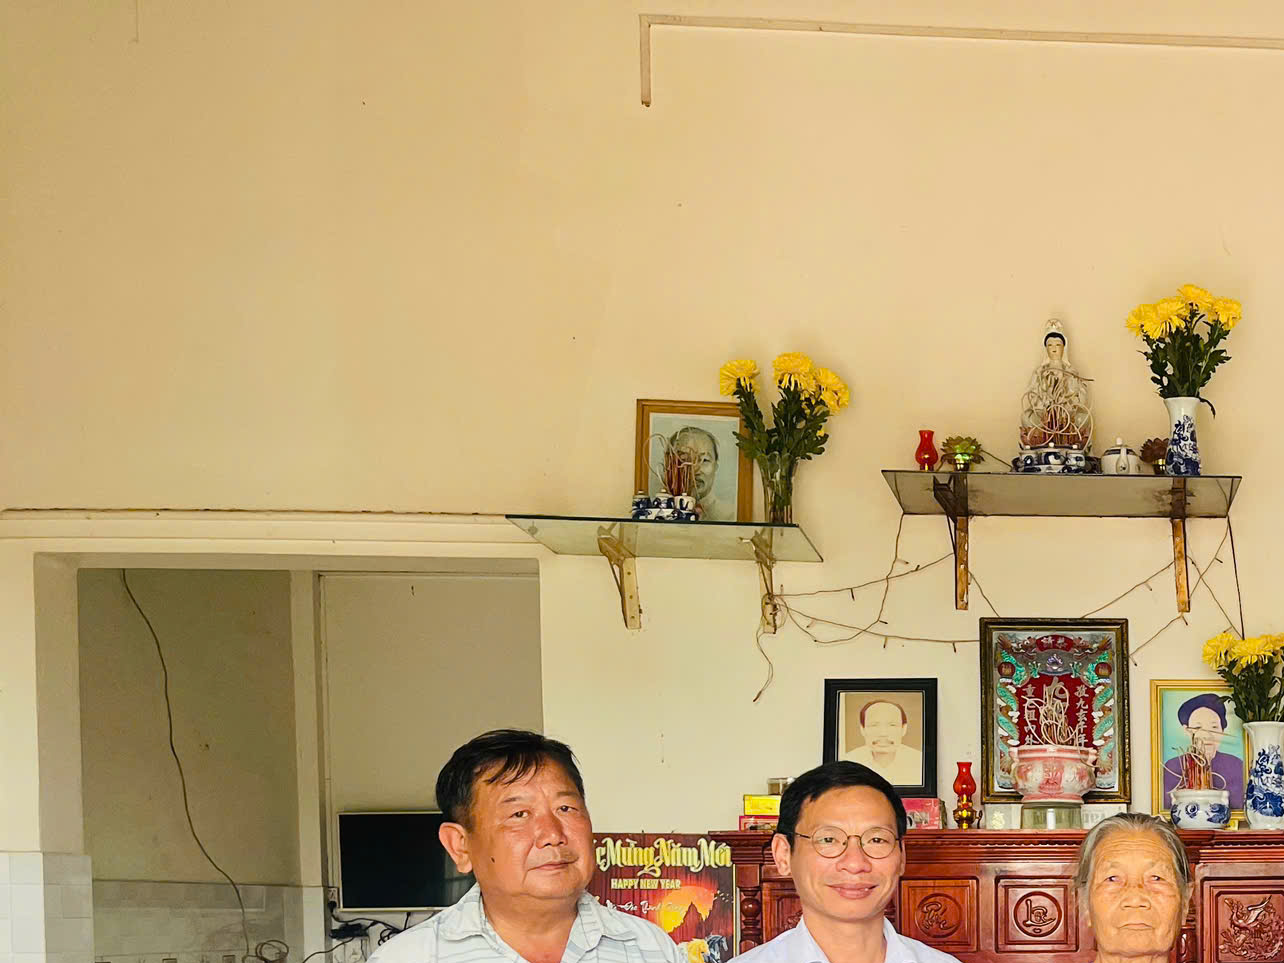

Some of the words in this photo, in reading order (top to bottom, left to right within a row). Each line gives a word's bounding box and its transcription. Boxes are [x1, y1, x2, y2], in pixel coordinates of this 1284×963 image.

[653, 837, 701, 868] Năm
[611, 878, 639, 889] HAPPY
[640, 878, 658, 889] NEW
[660, 878, 681, 889] YEAR
